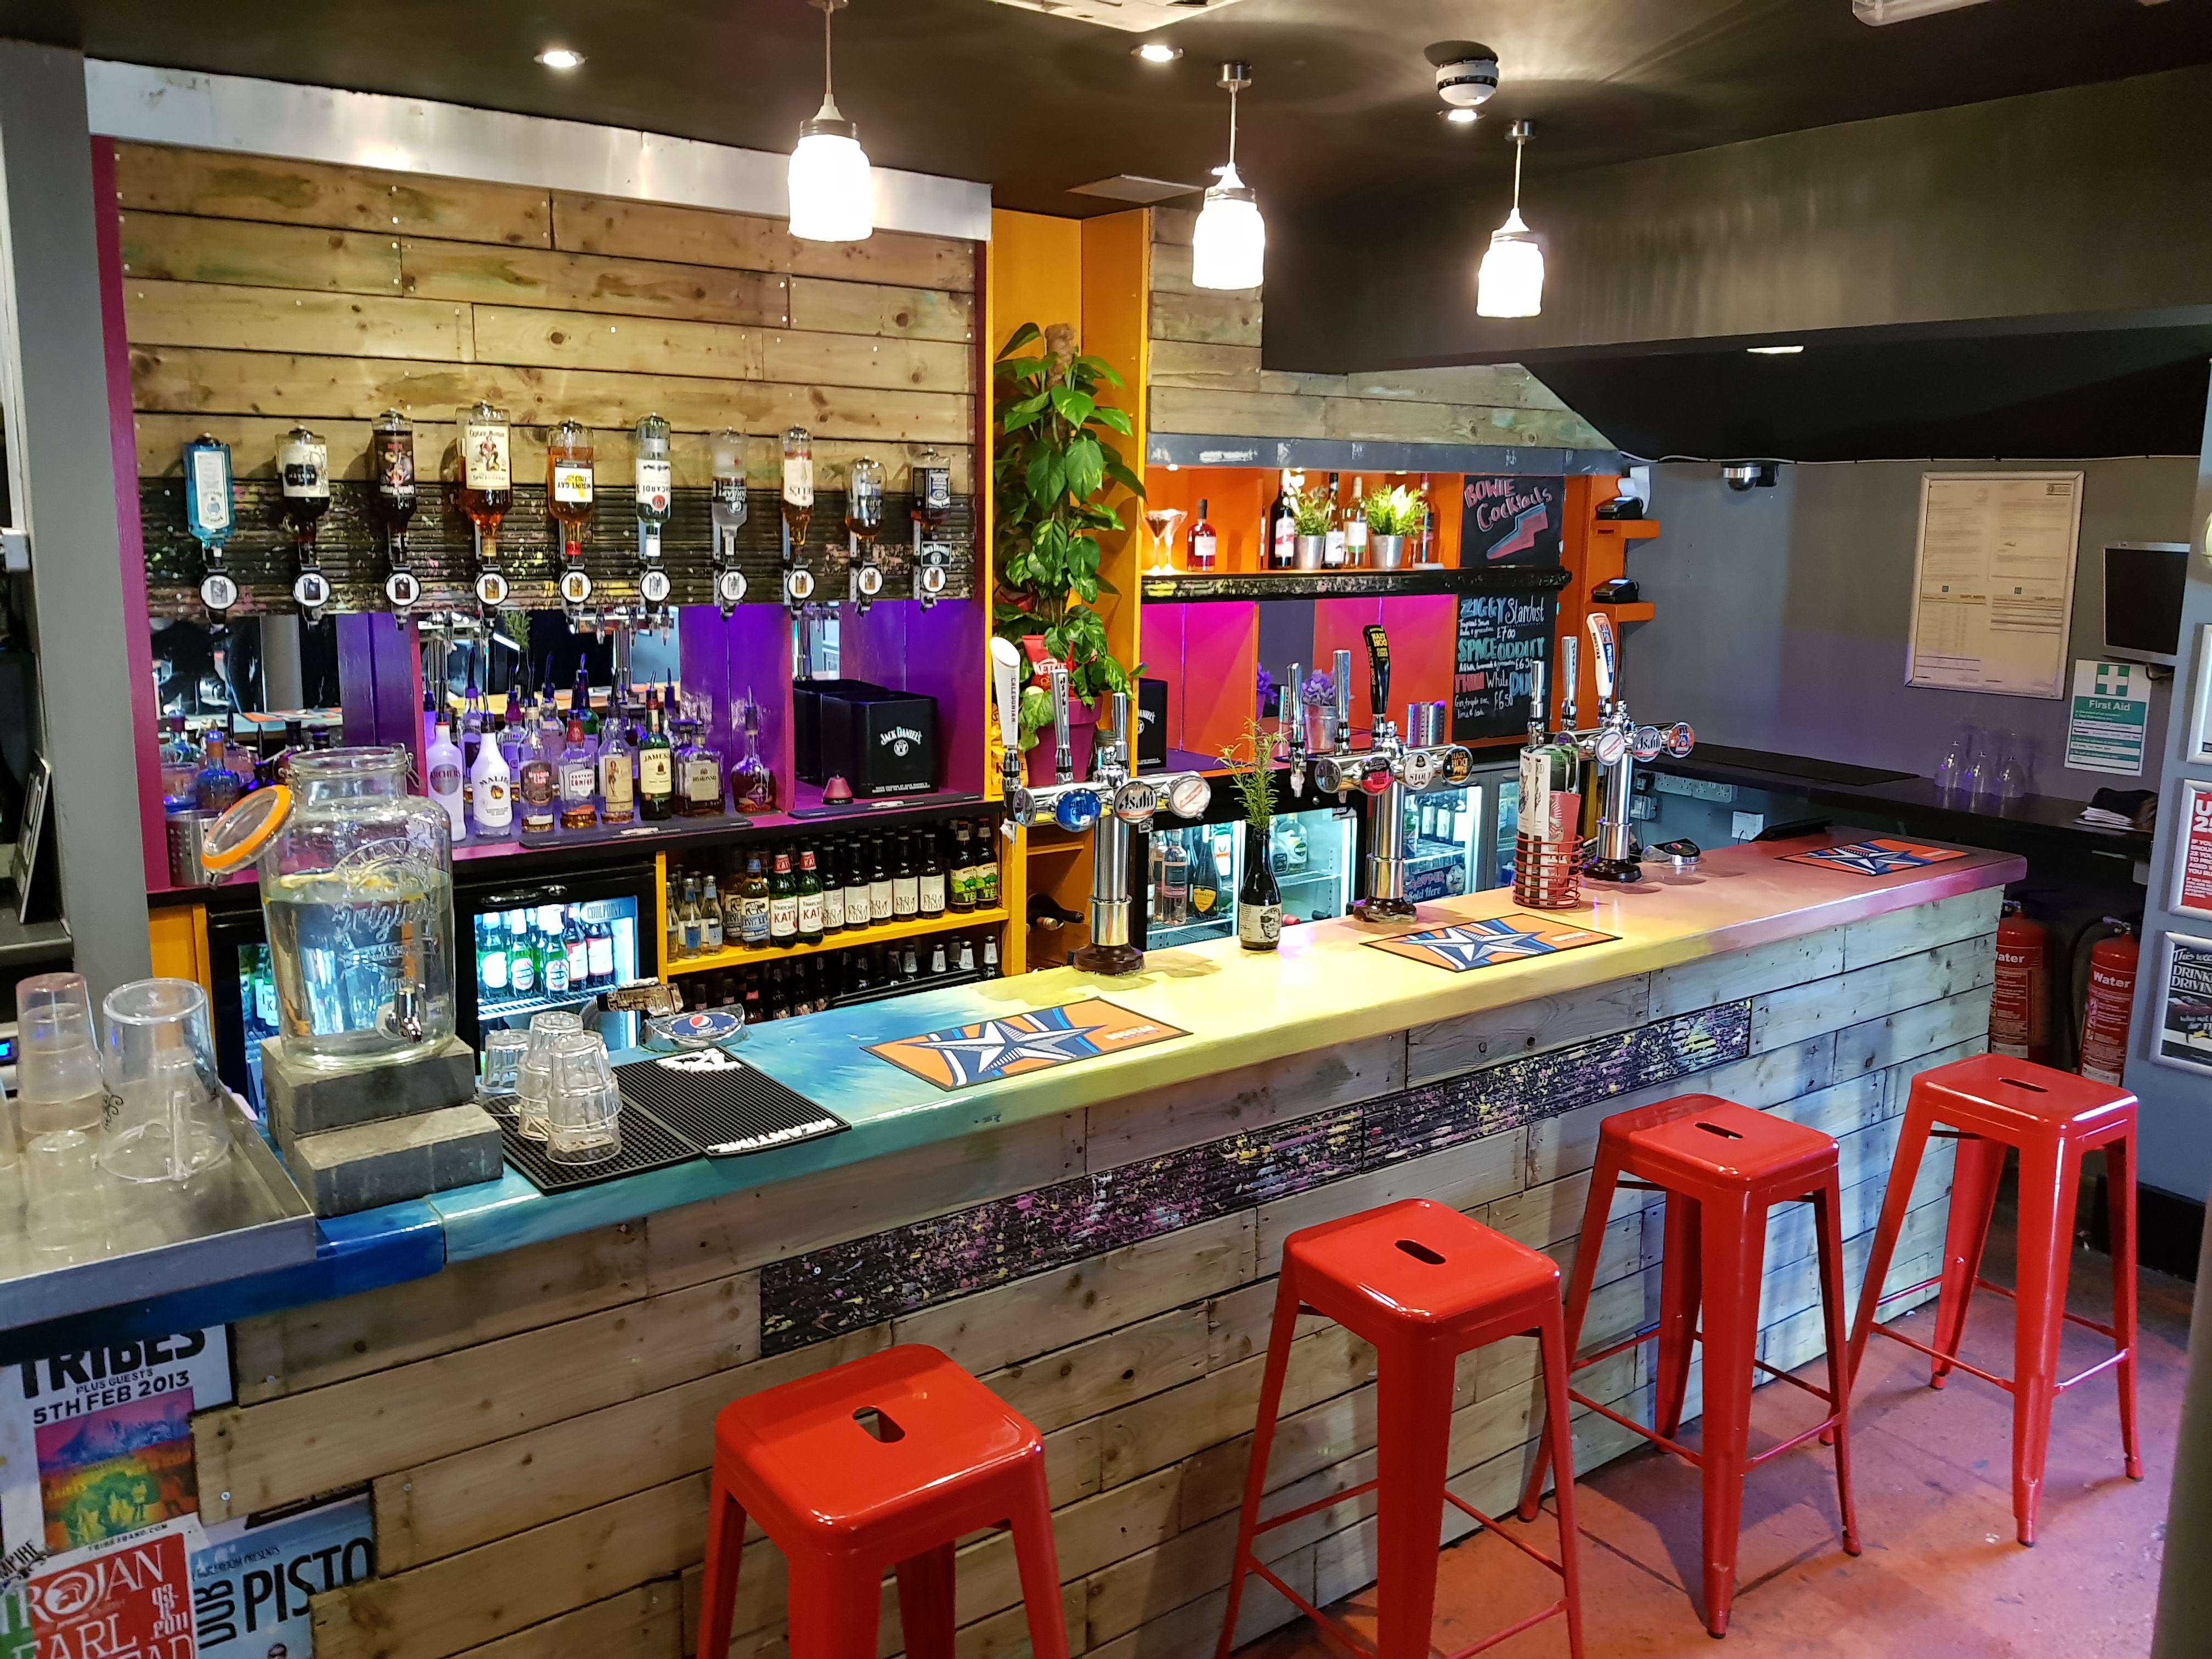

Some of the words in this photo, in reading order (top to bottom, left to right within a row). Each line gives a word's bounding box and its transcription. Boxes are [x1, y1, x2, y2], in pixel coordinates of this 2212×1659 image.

[1464, 478, 1516, 509] BOWIE
[1477, 487, 1553, 532] Cocktails
[1460, 596, 1507, 624] ZIGGY
[1505, 595, 1545, 624] Stardust
[1458, 637, 1497, 662] SPACE
[1497, 636, 1545, 661] ODDITY
[1510, 672, 1546, 696] DU
[2089, 699, 2112, 709] First
[2113, 702, 2131, 711] Aid
[880, 731, 897, 745] JACK
[896, 725, 923, 745] DANIEL'S
[1451, 751, 1466, 759] HAZY
[1451, 758, 1468, 767] HOG
[430, 769, 461, 779] ARCHERS
[1409, 772, 1431, 781] STOUT
[1119, 789, 1154, 811] Asahi
[1408, 890, 1424, 900] Sold
[1425, 887, 1441, 898] Here
[587, 903, 622, 918] COOLPOINT
[2173, 948, 2194, 962] This
[2094, 970, 2132, 988] Water
[2172, 964, 2212, 983] DRINK
[20, 1330, 206, 1400] TRIBES
[76, 1380, 106, 1395] PLUS
[109, 1368, 154, 1386] GUESTS
[33, 1395, 81, 1425] 5TH
[86, 1384, 132, 1412] FEB
[138, 1369, 190, 1398] 2013
[193, 1578, 238, 1650] DUB
